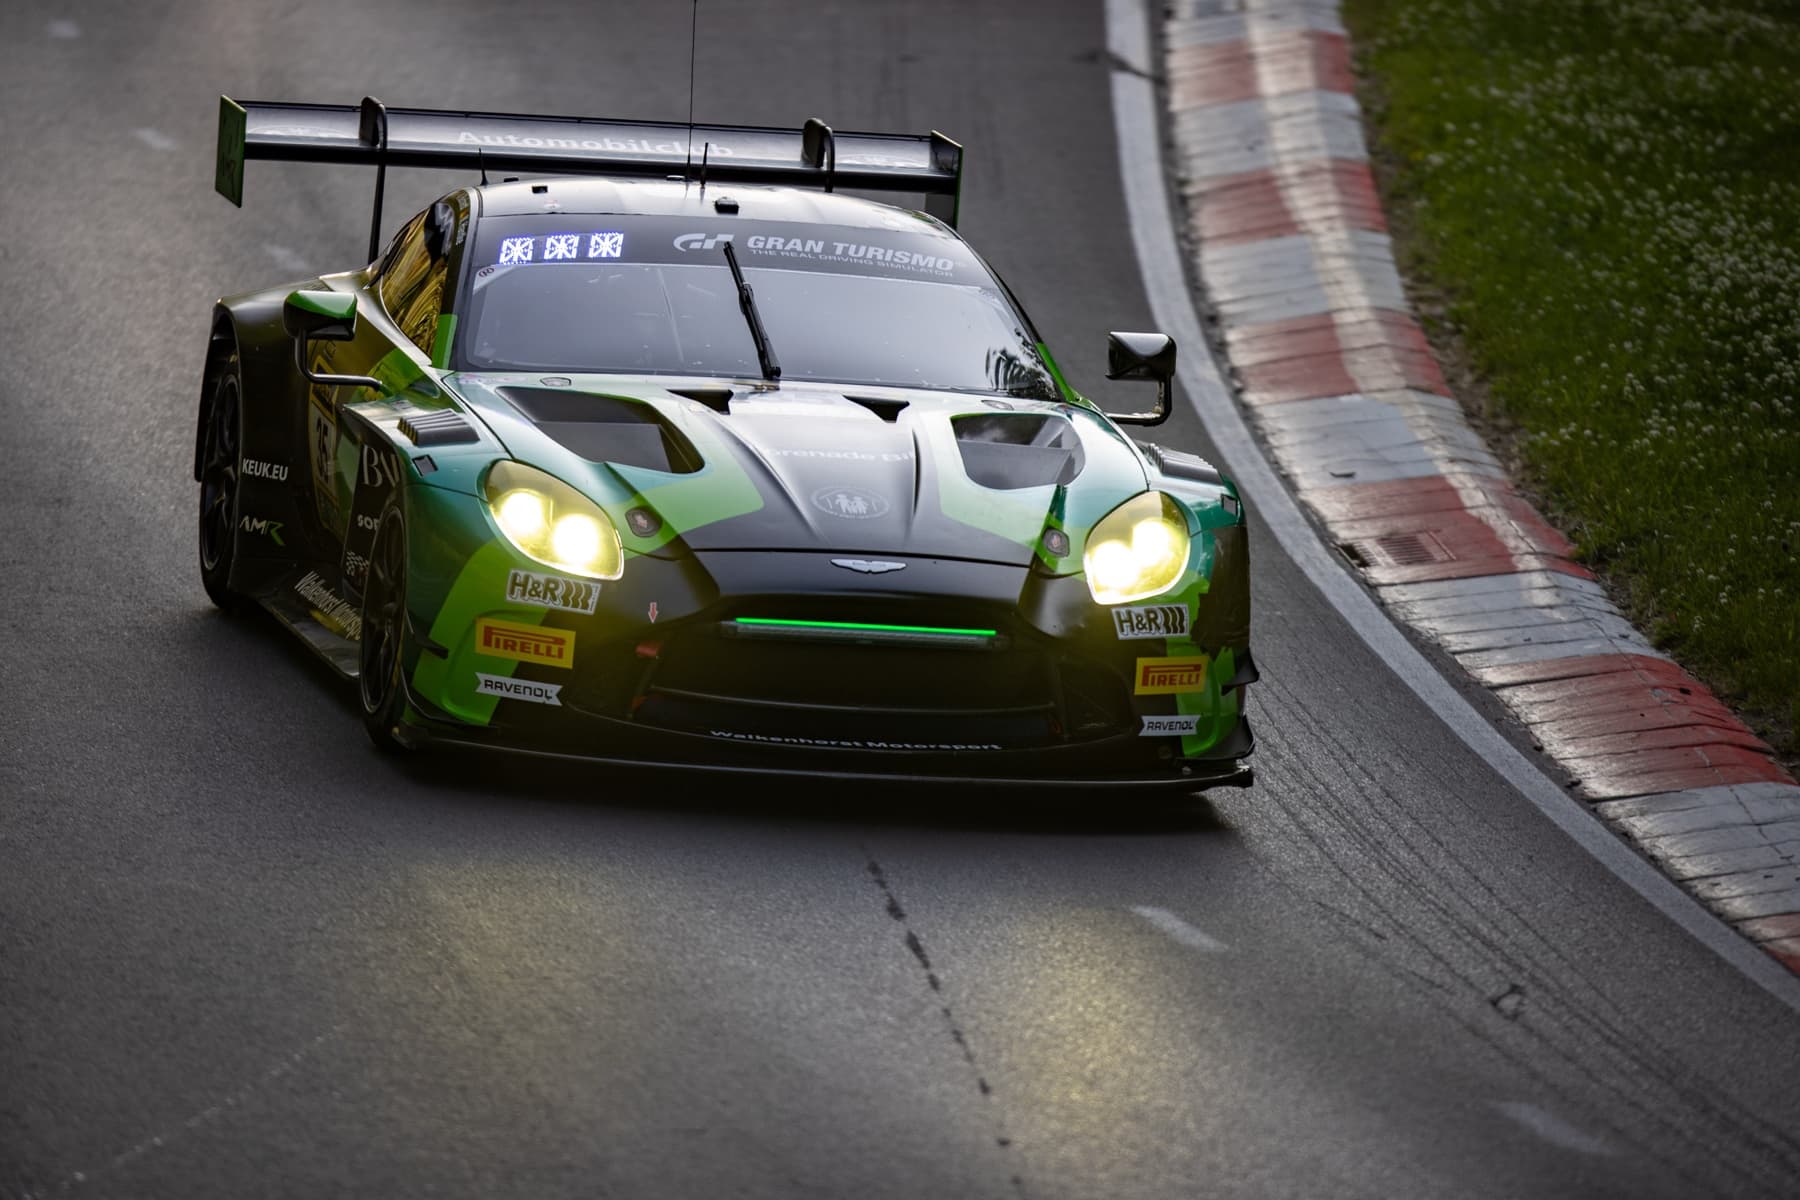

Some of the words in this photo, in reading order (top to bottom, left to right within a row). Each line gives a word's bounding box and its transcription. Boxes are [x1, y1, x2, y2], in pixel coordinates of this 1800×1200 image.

[747, 235, 825, 254] GRAN
[833, 242, 954, 271] TURISMO
[819, 255, 873, 266] DRIVING
[877, 262, 953, 277] SIMULATOR
[242, 458, 289, 481] KEUK.EU
[483, 625, 566, 660] PIRELLI
[1141, 663, 1202, 687] PIRELLI
[484, 679, 553, 700] RAVENOL
[1147, 721, 1194, 731] RAVENOL
[710, 730, 862, 747] Walkenhorst
[867, 741, 1003, 750] Motorsport
